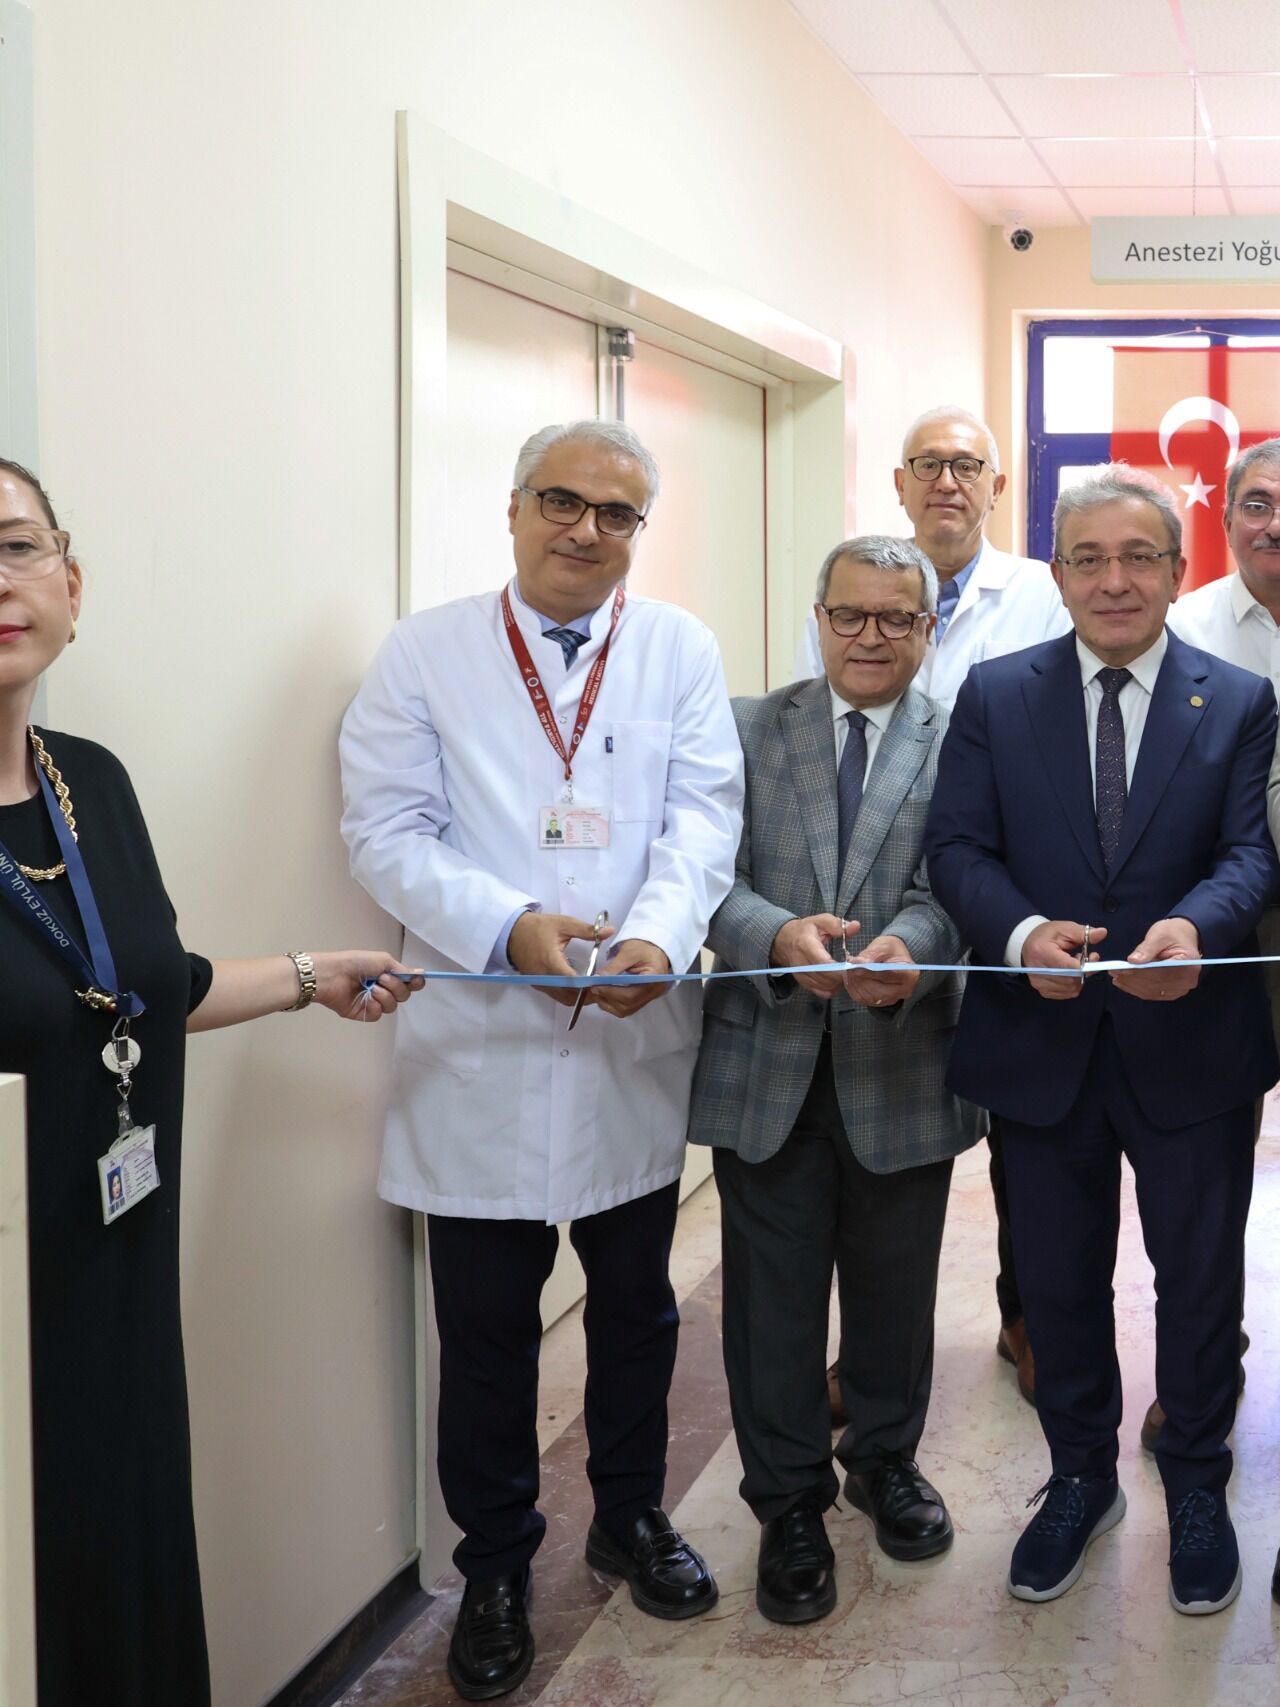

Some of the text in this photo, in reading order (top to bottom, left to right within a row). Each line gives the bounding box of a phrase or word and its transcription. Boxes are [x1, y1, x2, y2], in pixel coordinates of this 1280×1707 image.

[1124, 241, 1223, 263] Anestezi
[11, 873, 41, 910] EYLÜL
[36, 908, 70, 948] DOKUZ
